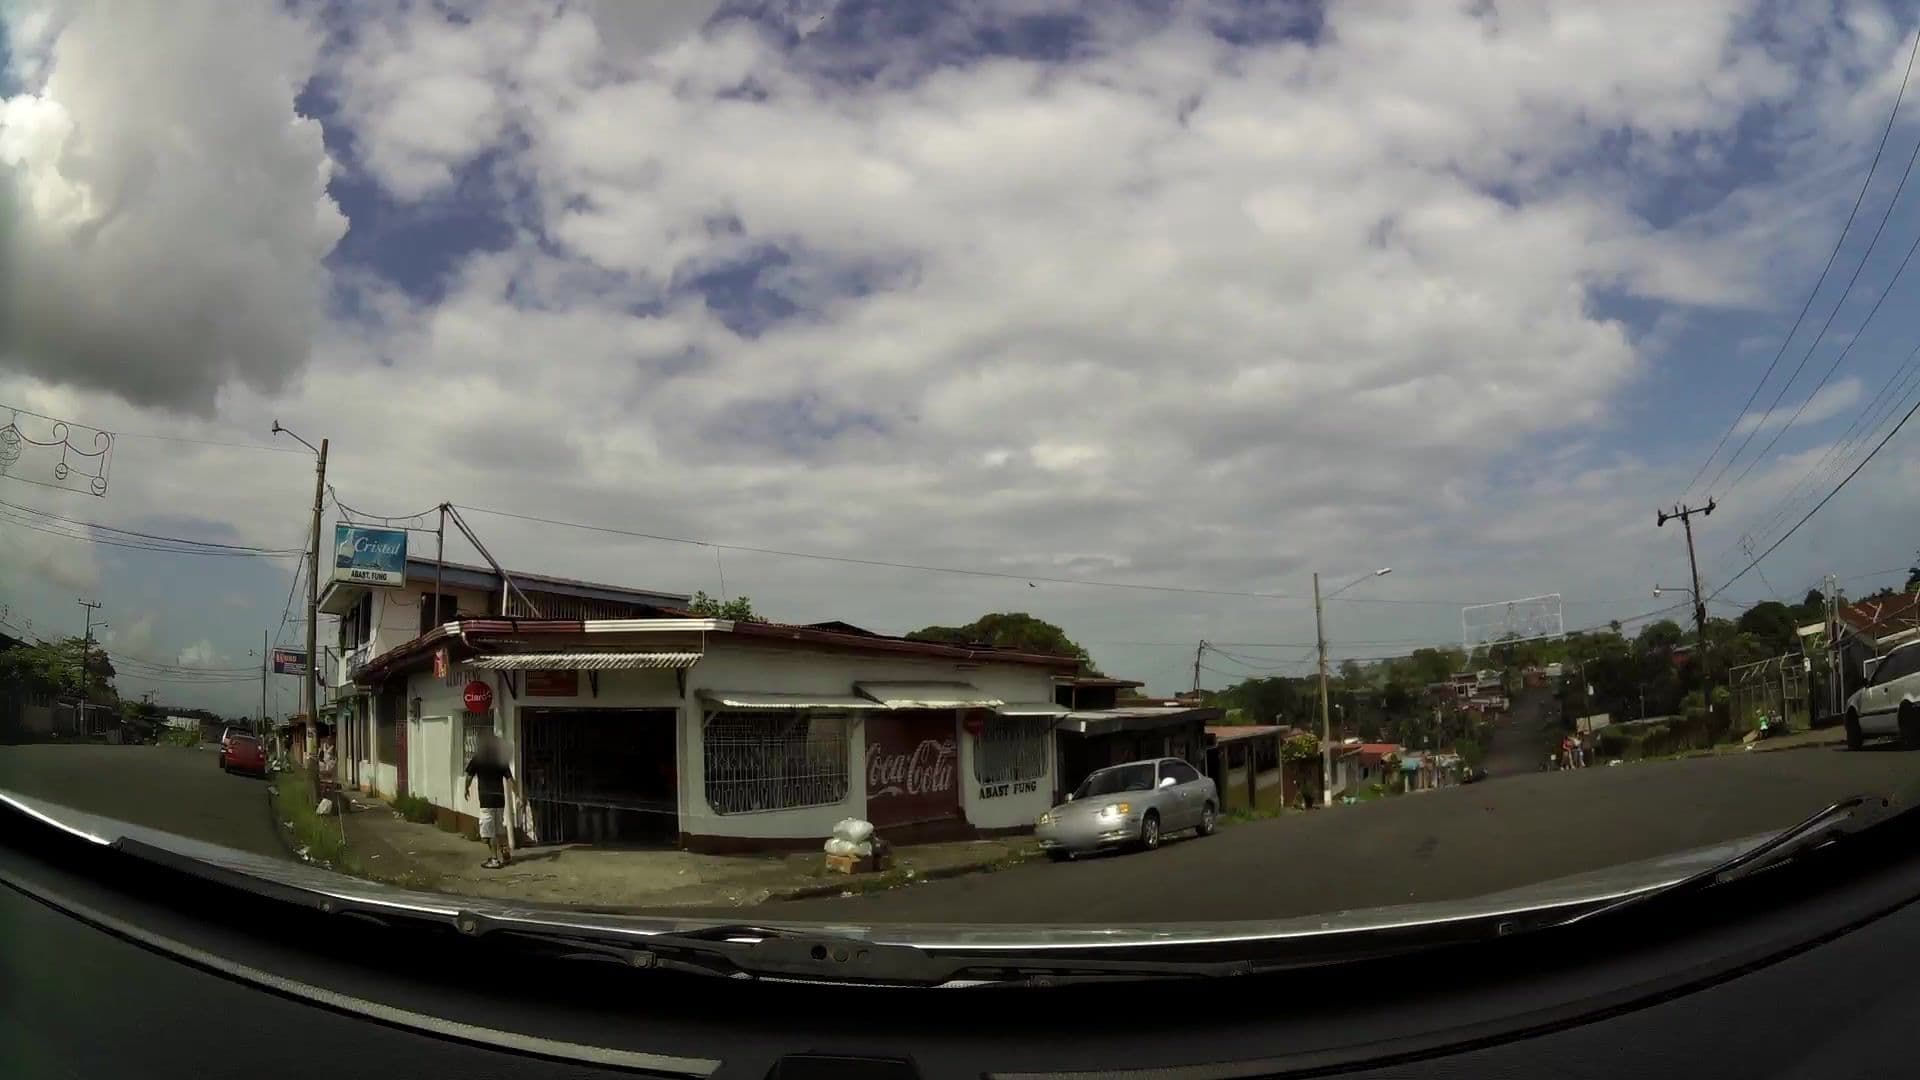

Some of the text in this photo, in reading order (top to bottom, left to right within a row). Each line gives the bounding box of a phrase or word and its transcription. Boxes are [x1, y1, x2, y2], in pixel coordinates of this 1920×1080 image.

[355, 536, 401, 555] Cristal
[371, 572, 388, 581] FUNG
[465, 693, 489, 702] Claro
[979, 781, 1037, 801] ABAST FUNG
